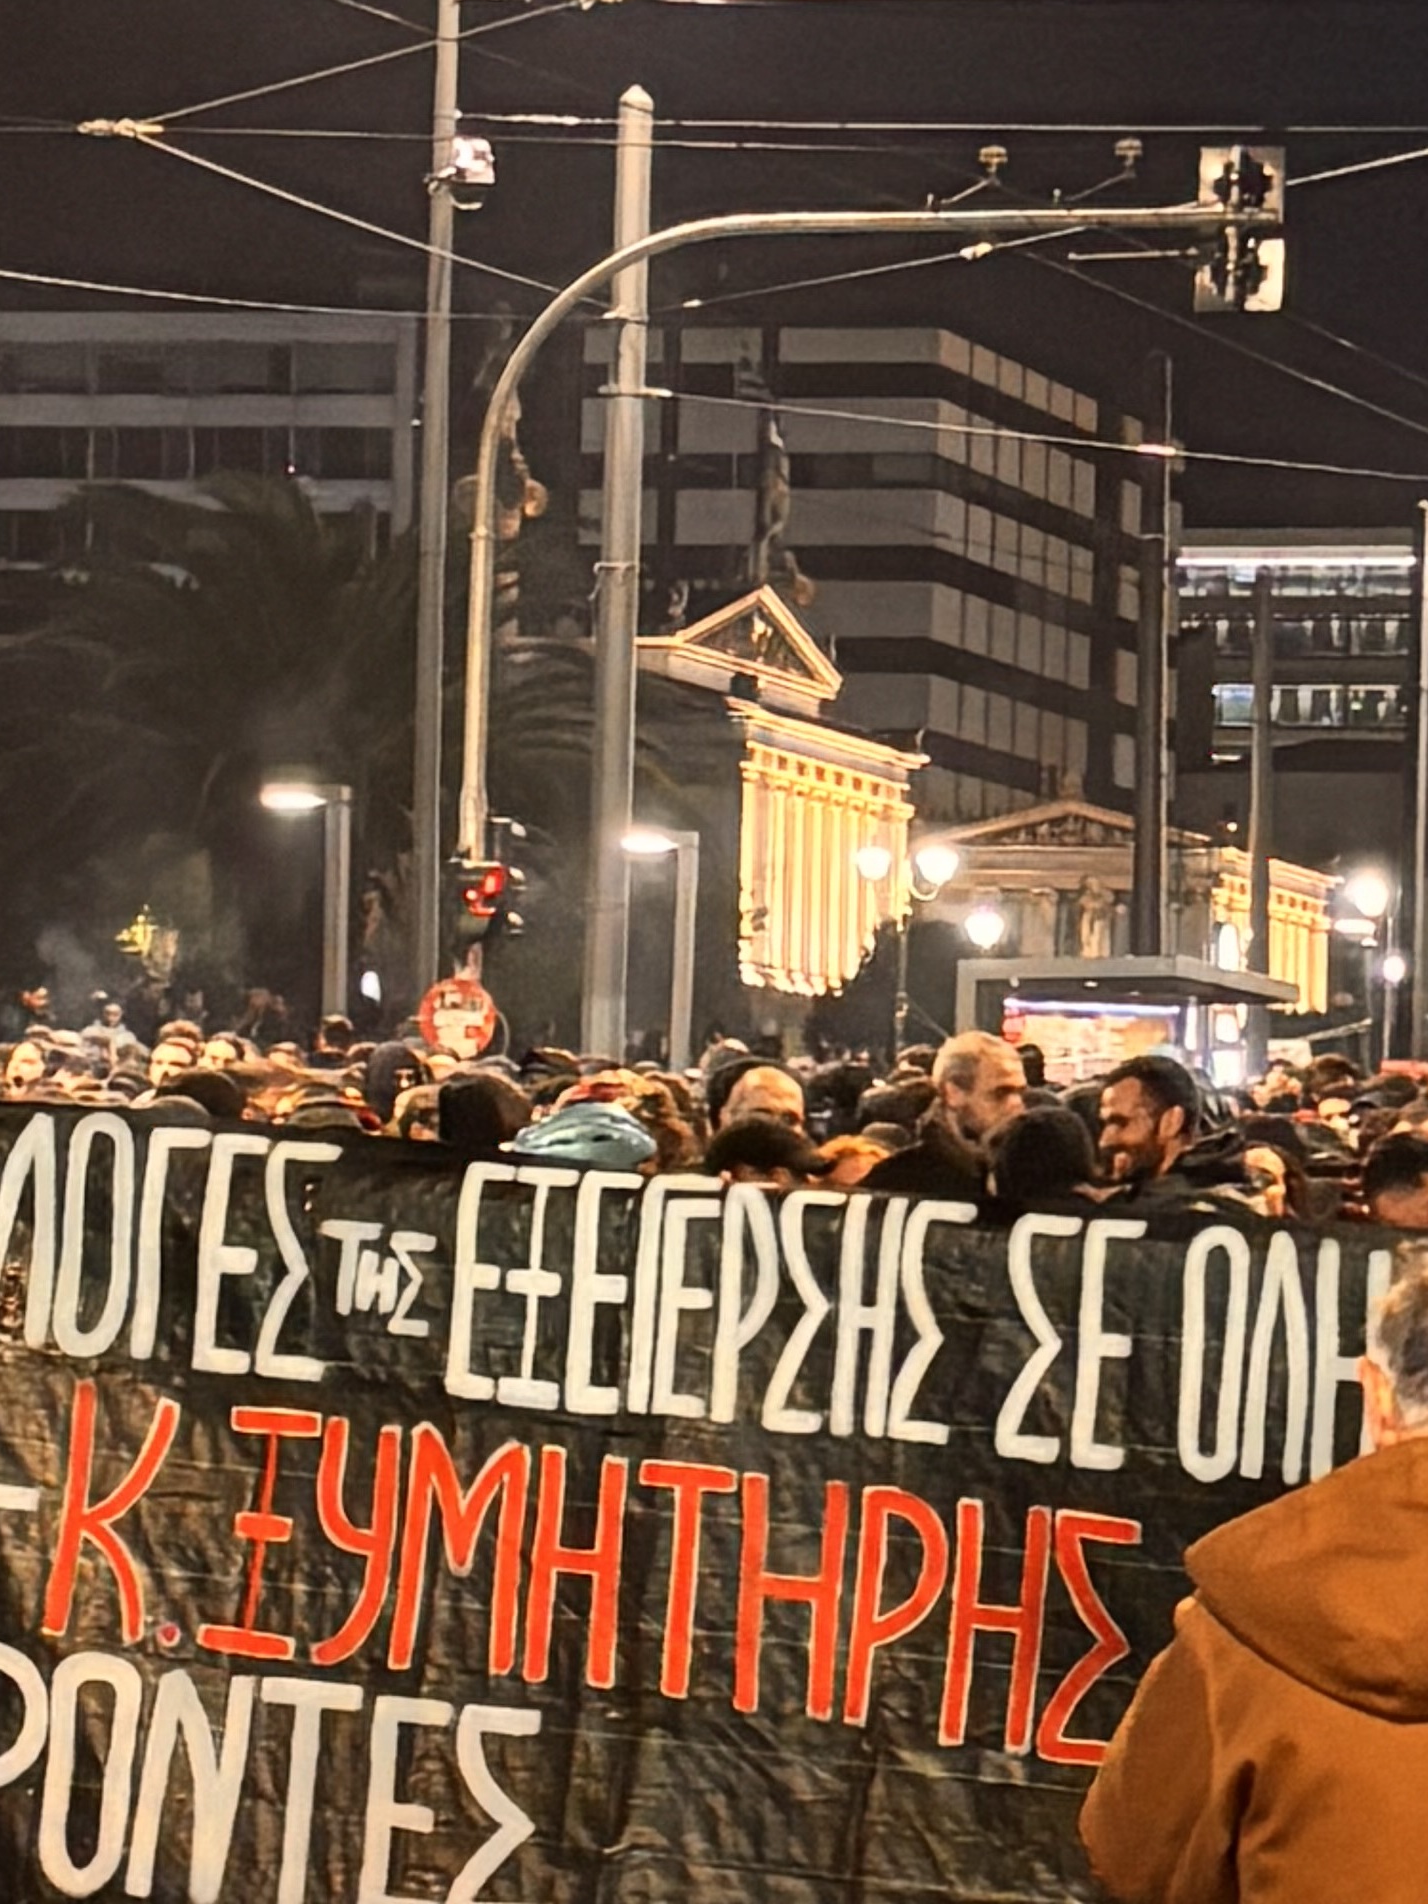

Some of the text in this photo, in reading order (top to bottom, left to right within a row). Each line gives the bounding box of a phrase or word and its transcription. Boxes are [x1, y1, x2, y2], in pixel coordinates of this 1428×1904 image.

[320, 1218, 438, 1338] ΤΗΣ
[443, 1160, 979, 1445] ΕΞΕΓΕΡΣΗΣ
[994, 1213, 1148, 1471] ΣΕ
